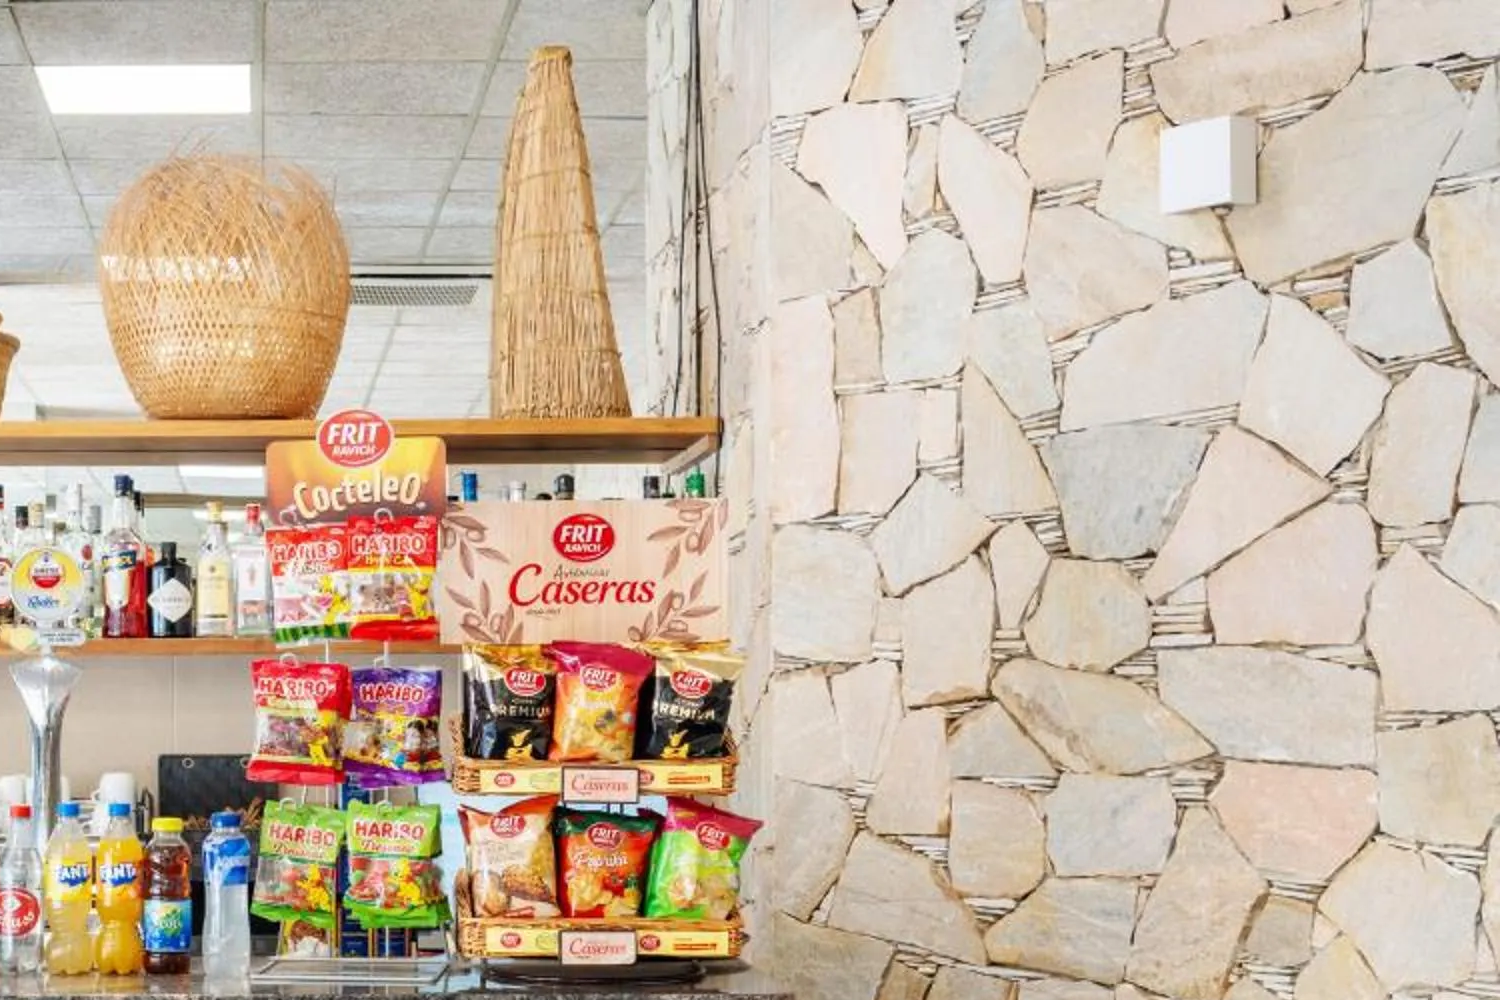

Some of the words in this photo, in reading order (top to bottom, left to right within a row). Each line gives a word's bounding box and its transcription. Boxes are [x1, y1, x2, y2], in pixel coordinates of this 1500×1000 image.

[327, 421, 383, 445] FRIT
[352, 533, 427, 555] HARIBO
[559, 523, 608, 544] FRIT
[272, 540, 342, 562] HARIBO
[508, 562, 657, 607] Caseras
[510, 670, 539, 683] FRIT
[258, 677, 331, 699] HARIBO
[360, 683, 426, 701] HARIBO
[269, 822, 336, 846] HARIBO
[355, 820, 426, 841] HARIBO
[592, 827, 620, 840] FRIT
